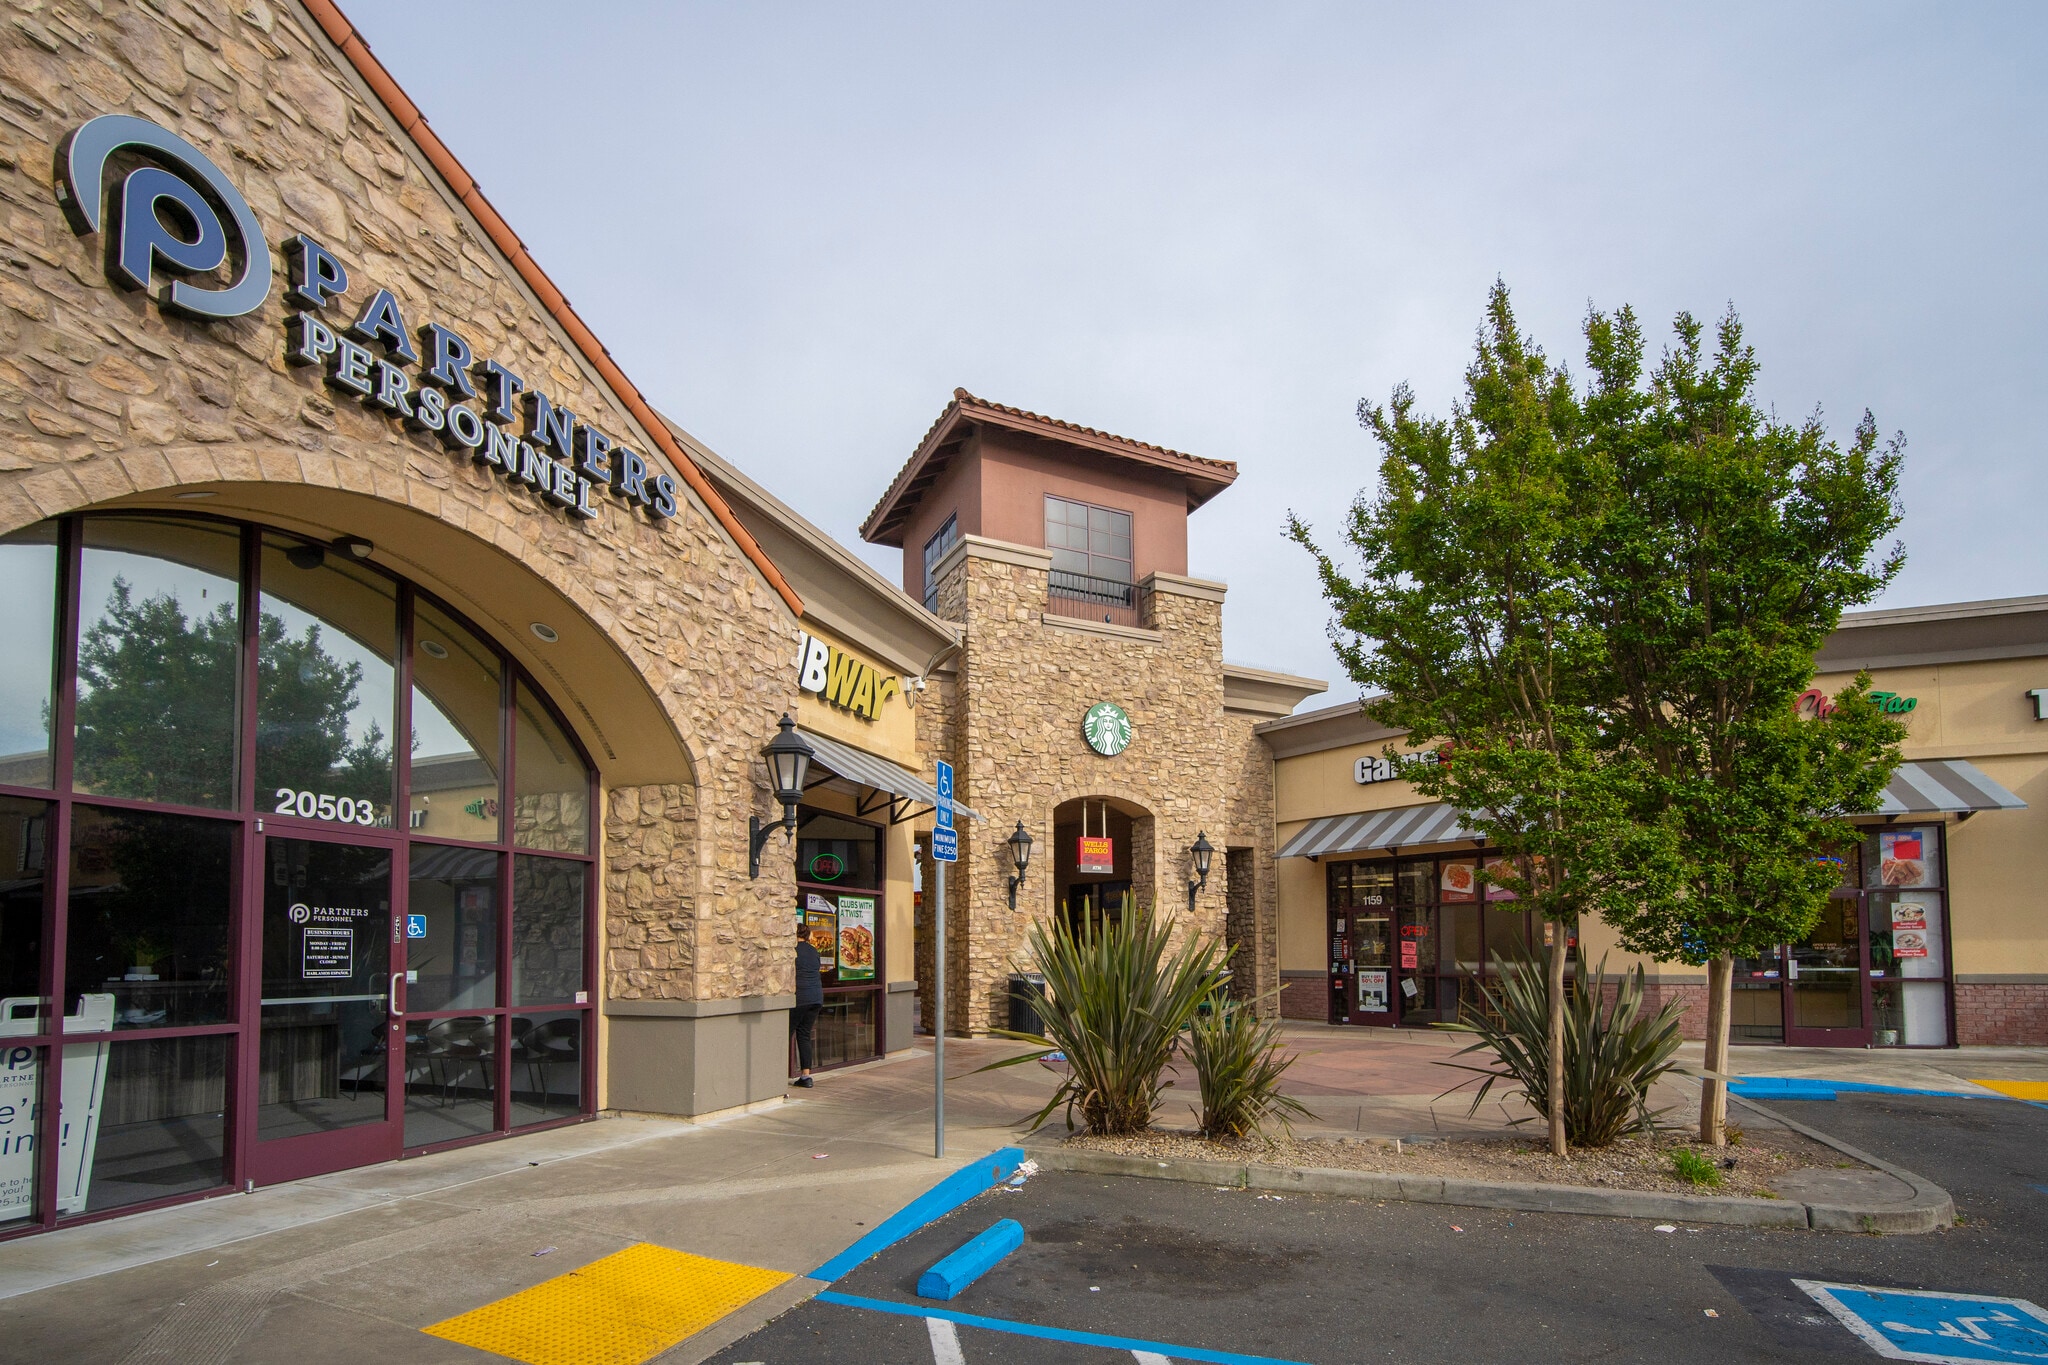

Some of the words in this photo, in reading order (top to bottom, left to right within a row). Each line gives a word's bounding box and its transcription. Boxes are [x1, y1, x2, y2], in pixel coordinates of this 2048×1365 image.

[298, 234, 678, 520] PARTNERS
[299, 312, 598, 520] PERSONNEL
[798, 630, 900, 721] BWAY
[1868, 691, 1918, 713] Tao
[275, 788, 374, 825] 20503
[934, 832, 956, 845] MINIMUM
[934, 843, 944, 854] FINE
[944, 845, 956, 856] $250
[840, 900, 858, 909] CLUBS
[859, 901, 872, 909] WITH
[1362, 895, 1383, 905] 1159
[313, 907, 369, 916] PARTNERS
[840, 909, 845, 917] A
[846, 909, 863, 918] TWIST.
[1401, 926, 1428, 937] OPEN
[3, 1074, 34, 1083] RTNE
